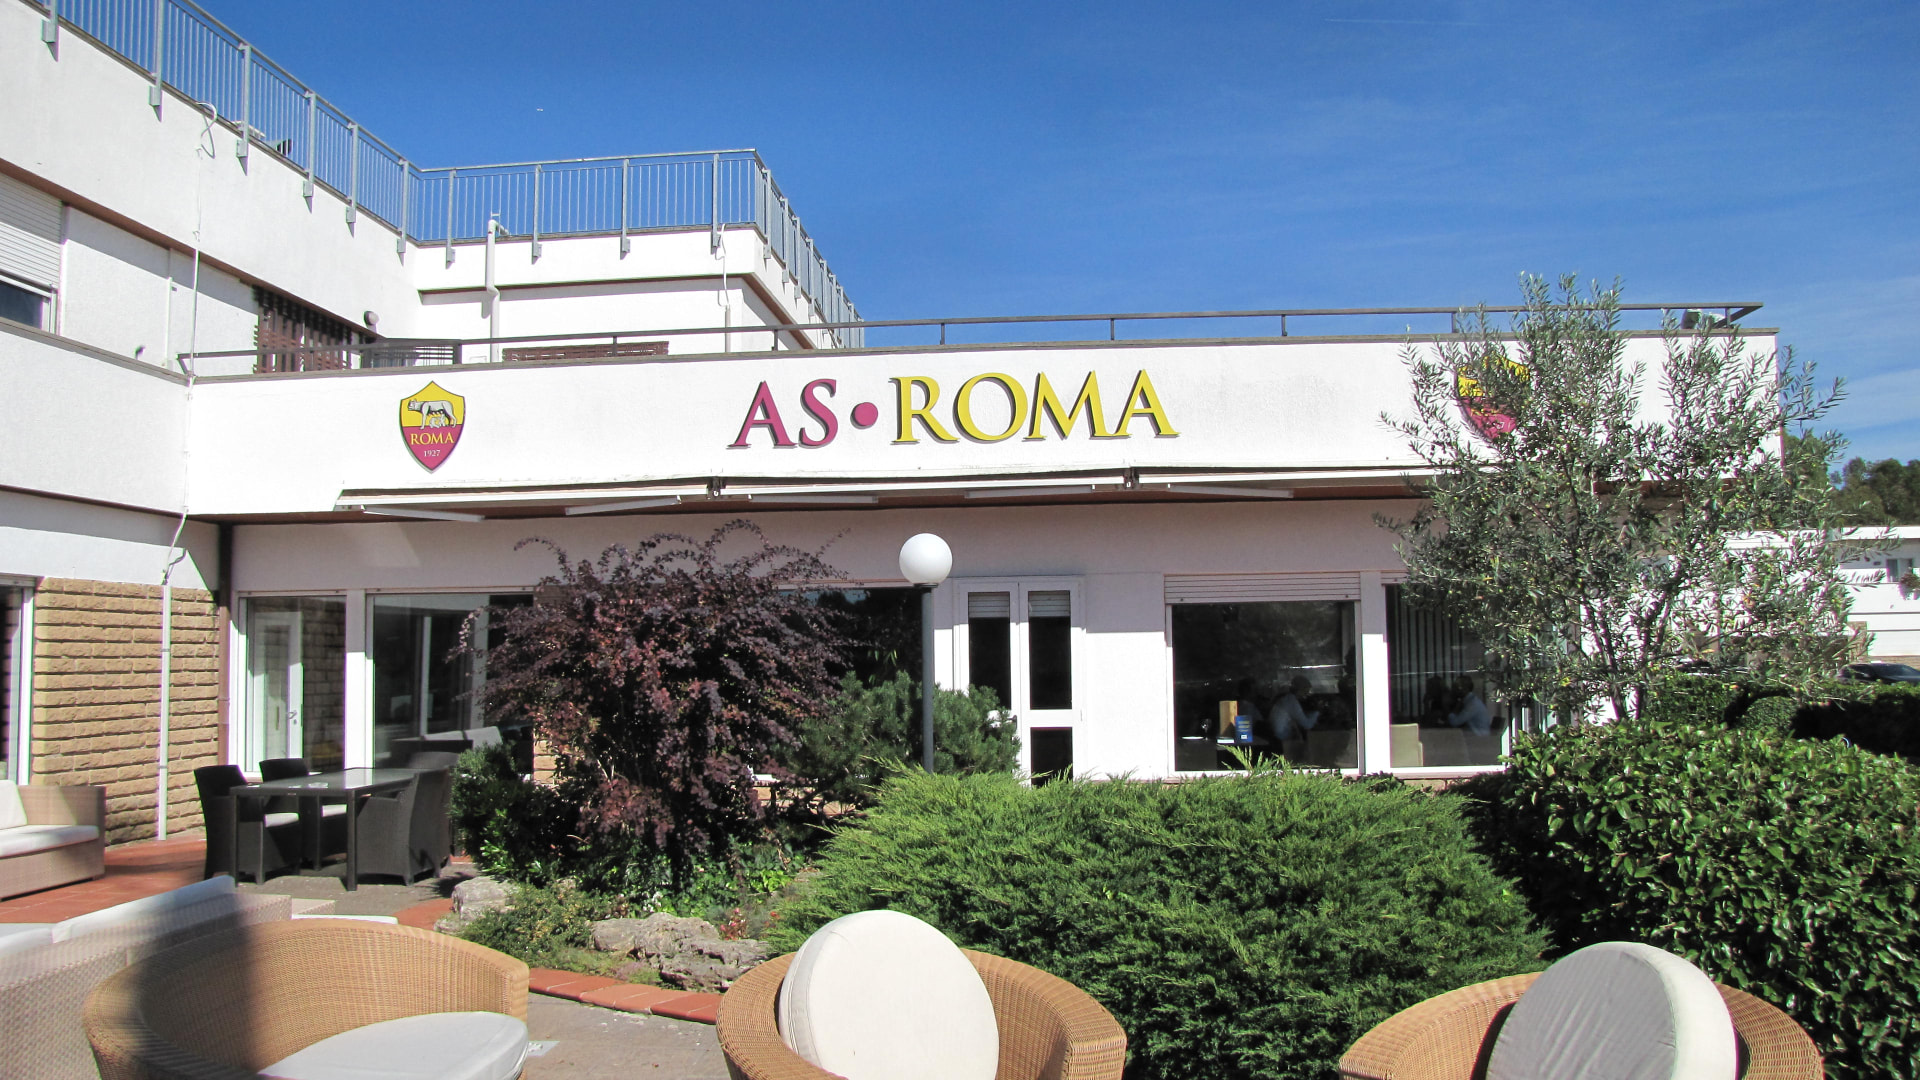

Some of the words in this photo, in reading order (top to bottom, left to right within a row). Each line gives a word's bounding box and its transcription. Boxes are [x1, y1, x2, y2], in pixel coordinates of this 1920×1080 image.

[729, 378, 840, 447] AS
[889, 368, 1181, 443] ROMA
[410, 432, 455, 445] ROMA
[423, 449, 441, 457] 1927
